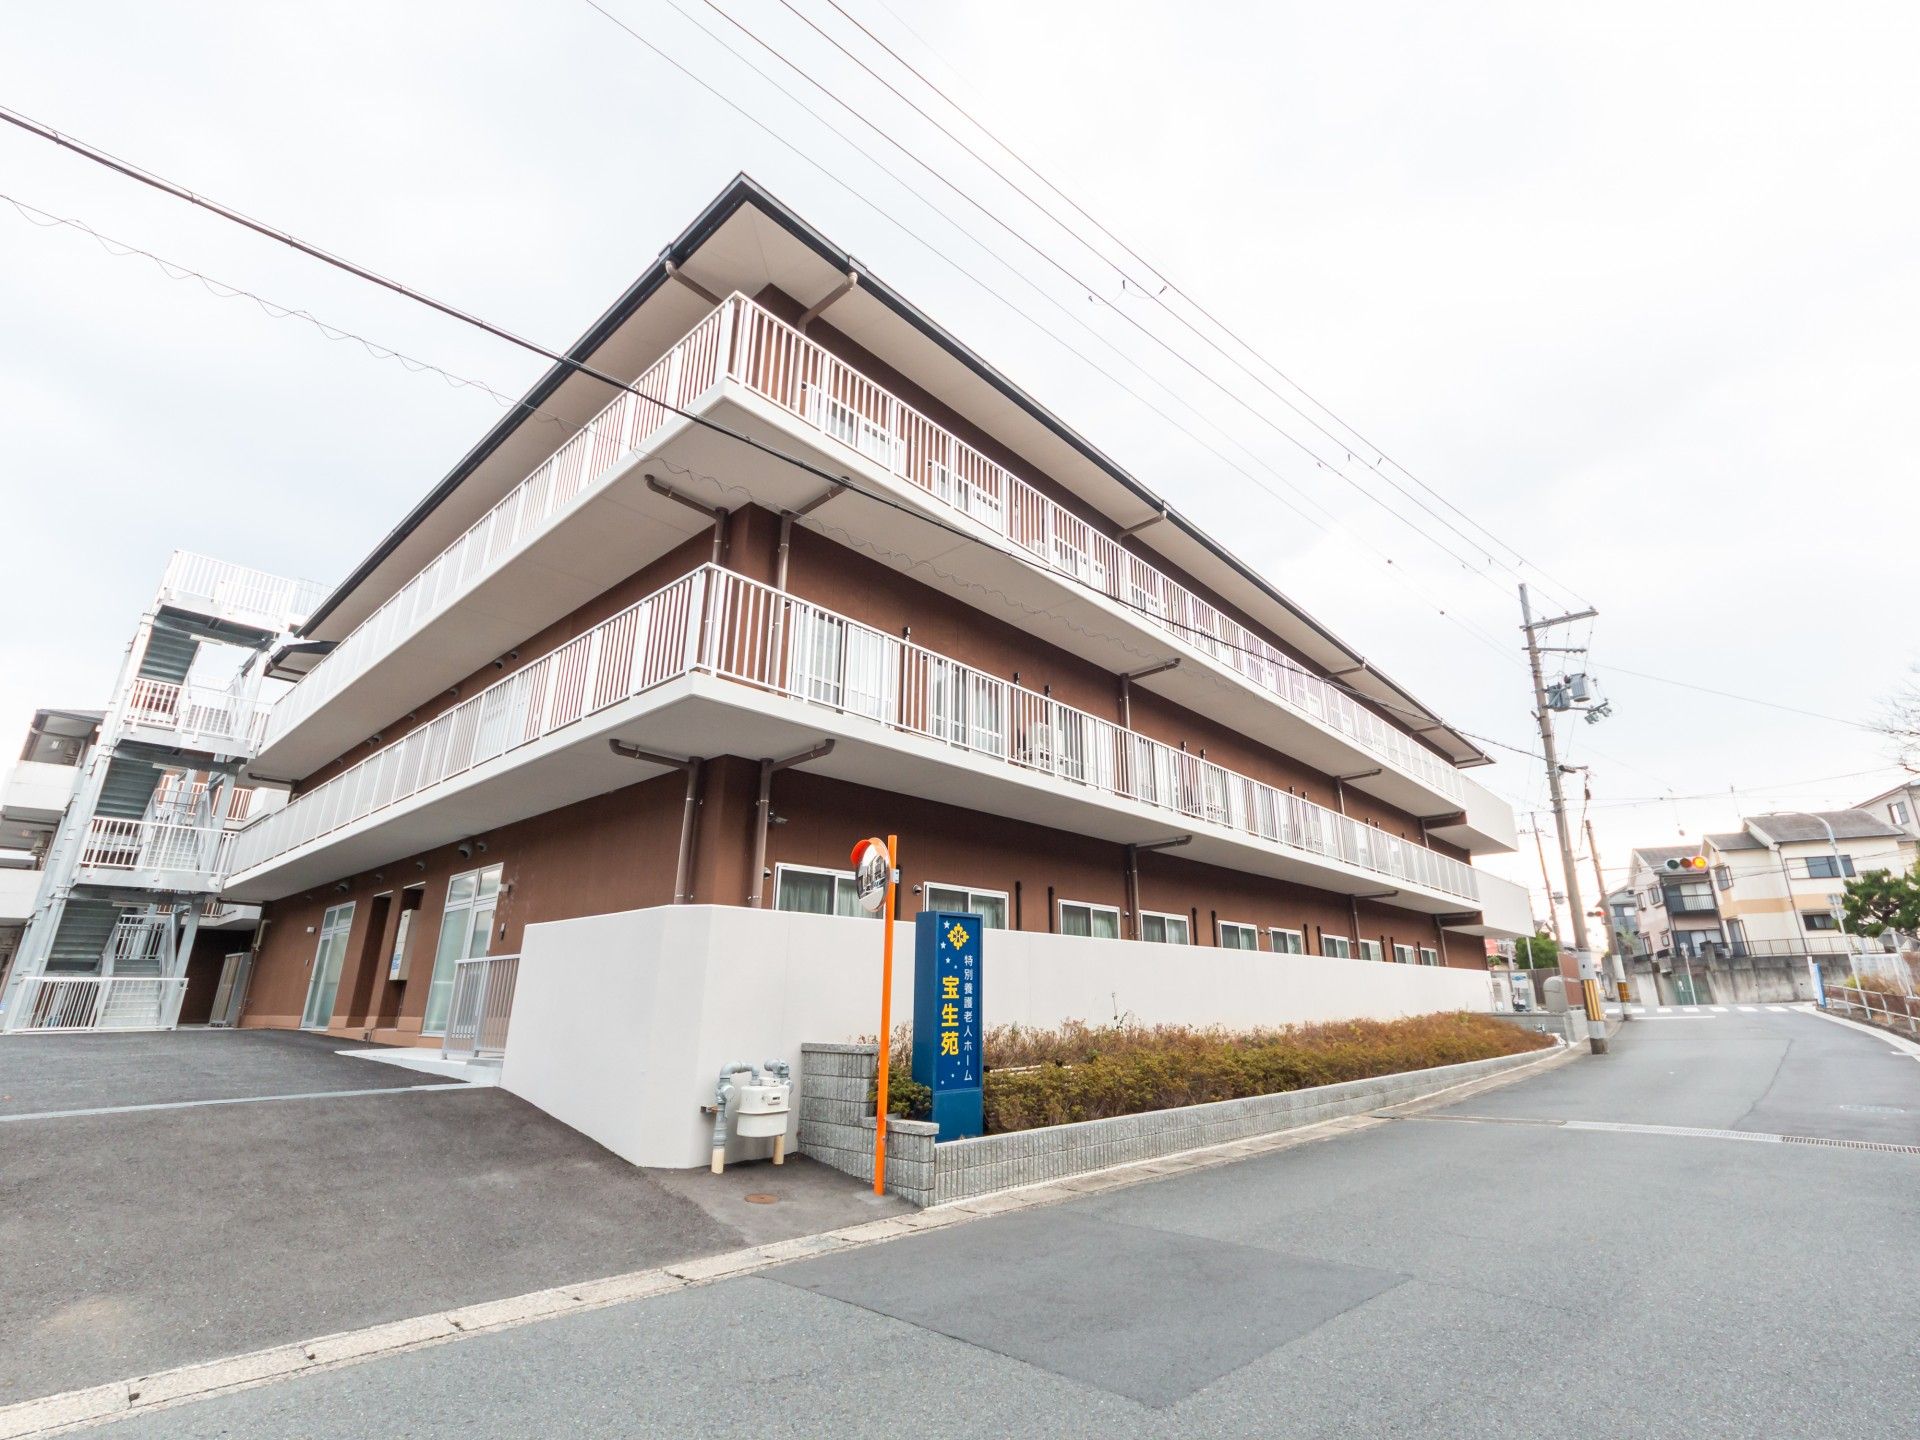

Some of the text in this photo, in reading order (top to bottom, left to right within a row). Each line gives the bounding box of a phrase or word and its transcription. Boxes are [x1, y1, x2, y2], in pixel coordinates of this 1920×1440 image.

[941, 975, 960, 1057] 宝生苑
[963, 955, 974, 1081] 特別養護老人ホーム
